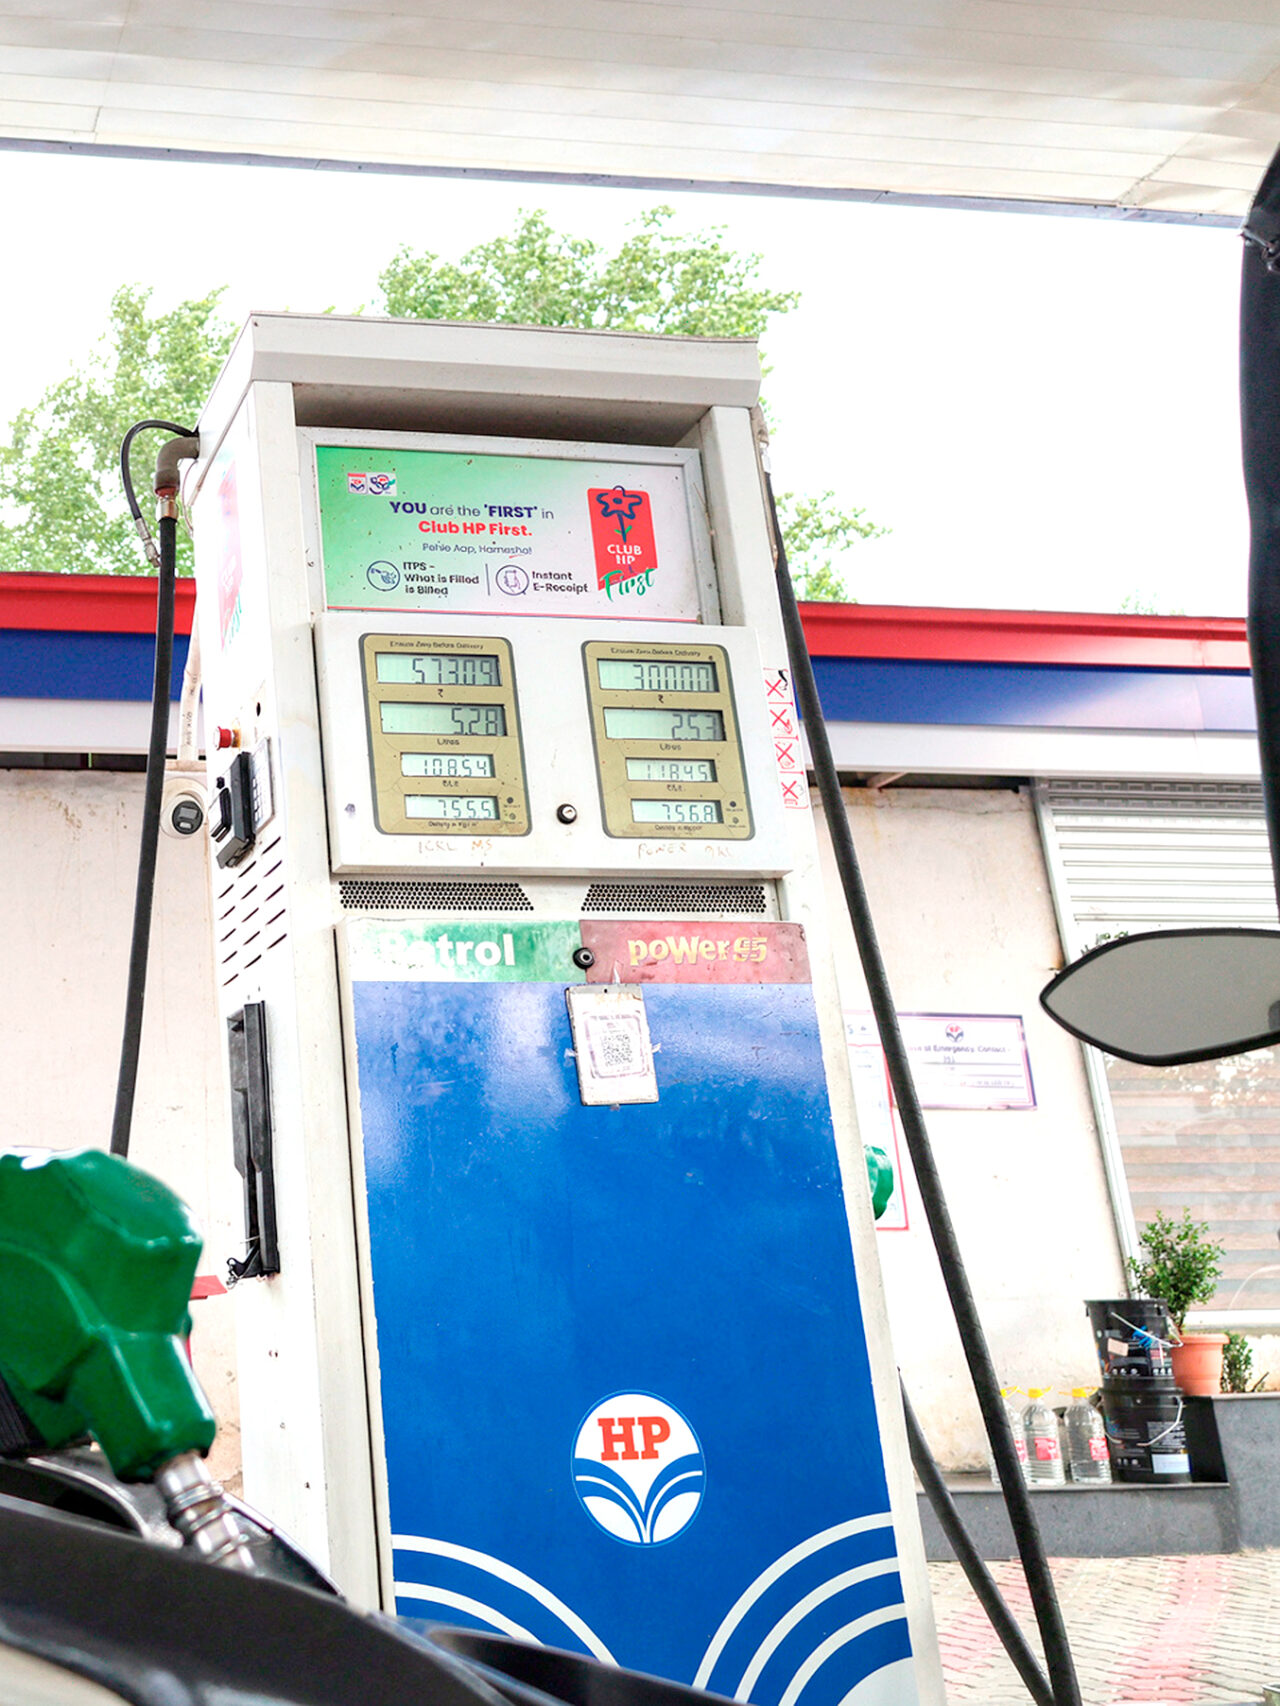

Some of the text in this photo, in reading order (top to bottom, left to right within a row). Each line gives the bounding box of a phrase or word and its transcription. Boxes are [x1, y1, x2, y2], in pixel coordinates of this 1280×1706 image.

[389, 501, 427, 514] YOU
[430, 506, 454, 516] are
[458, 505, 481, 517] the
[541, 509, 554, 519] in
[418, 520, 533, 537] Club HP First.
[607, 544, 642, 555] CLUB
[616, 554, 635, 564] HP
[403, 562, 426, 571] ITPS
[404, 574, 480, 584] What is Filled
[532, 571, 573, 581] Instant
[405, 585, 415, 594] is
[533, 582, 588, 595] E-Receipt
[597, 1416, 671, 1461] HP
